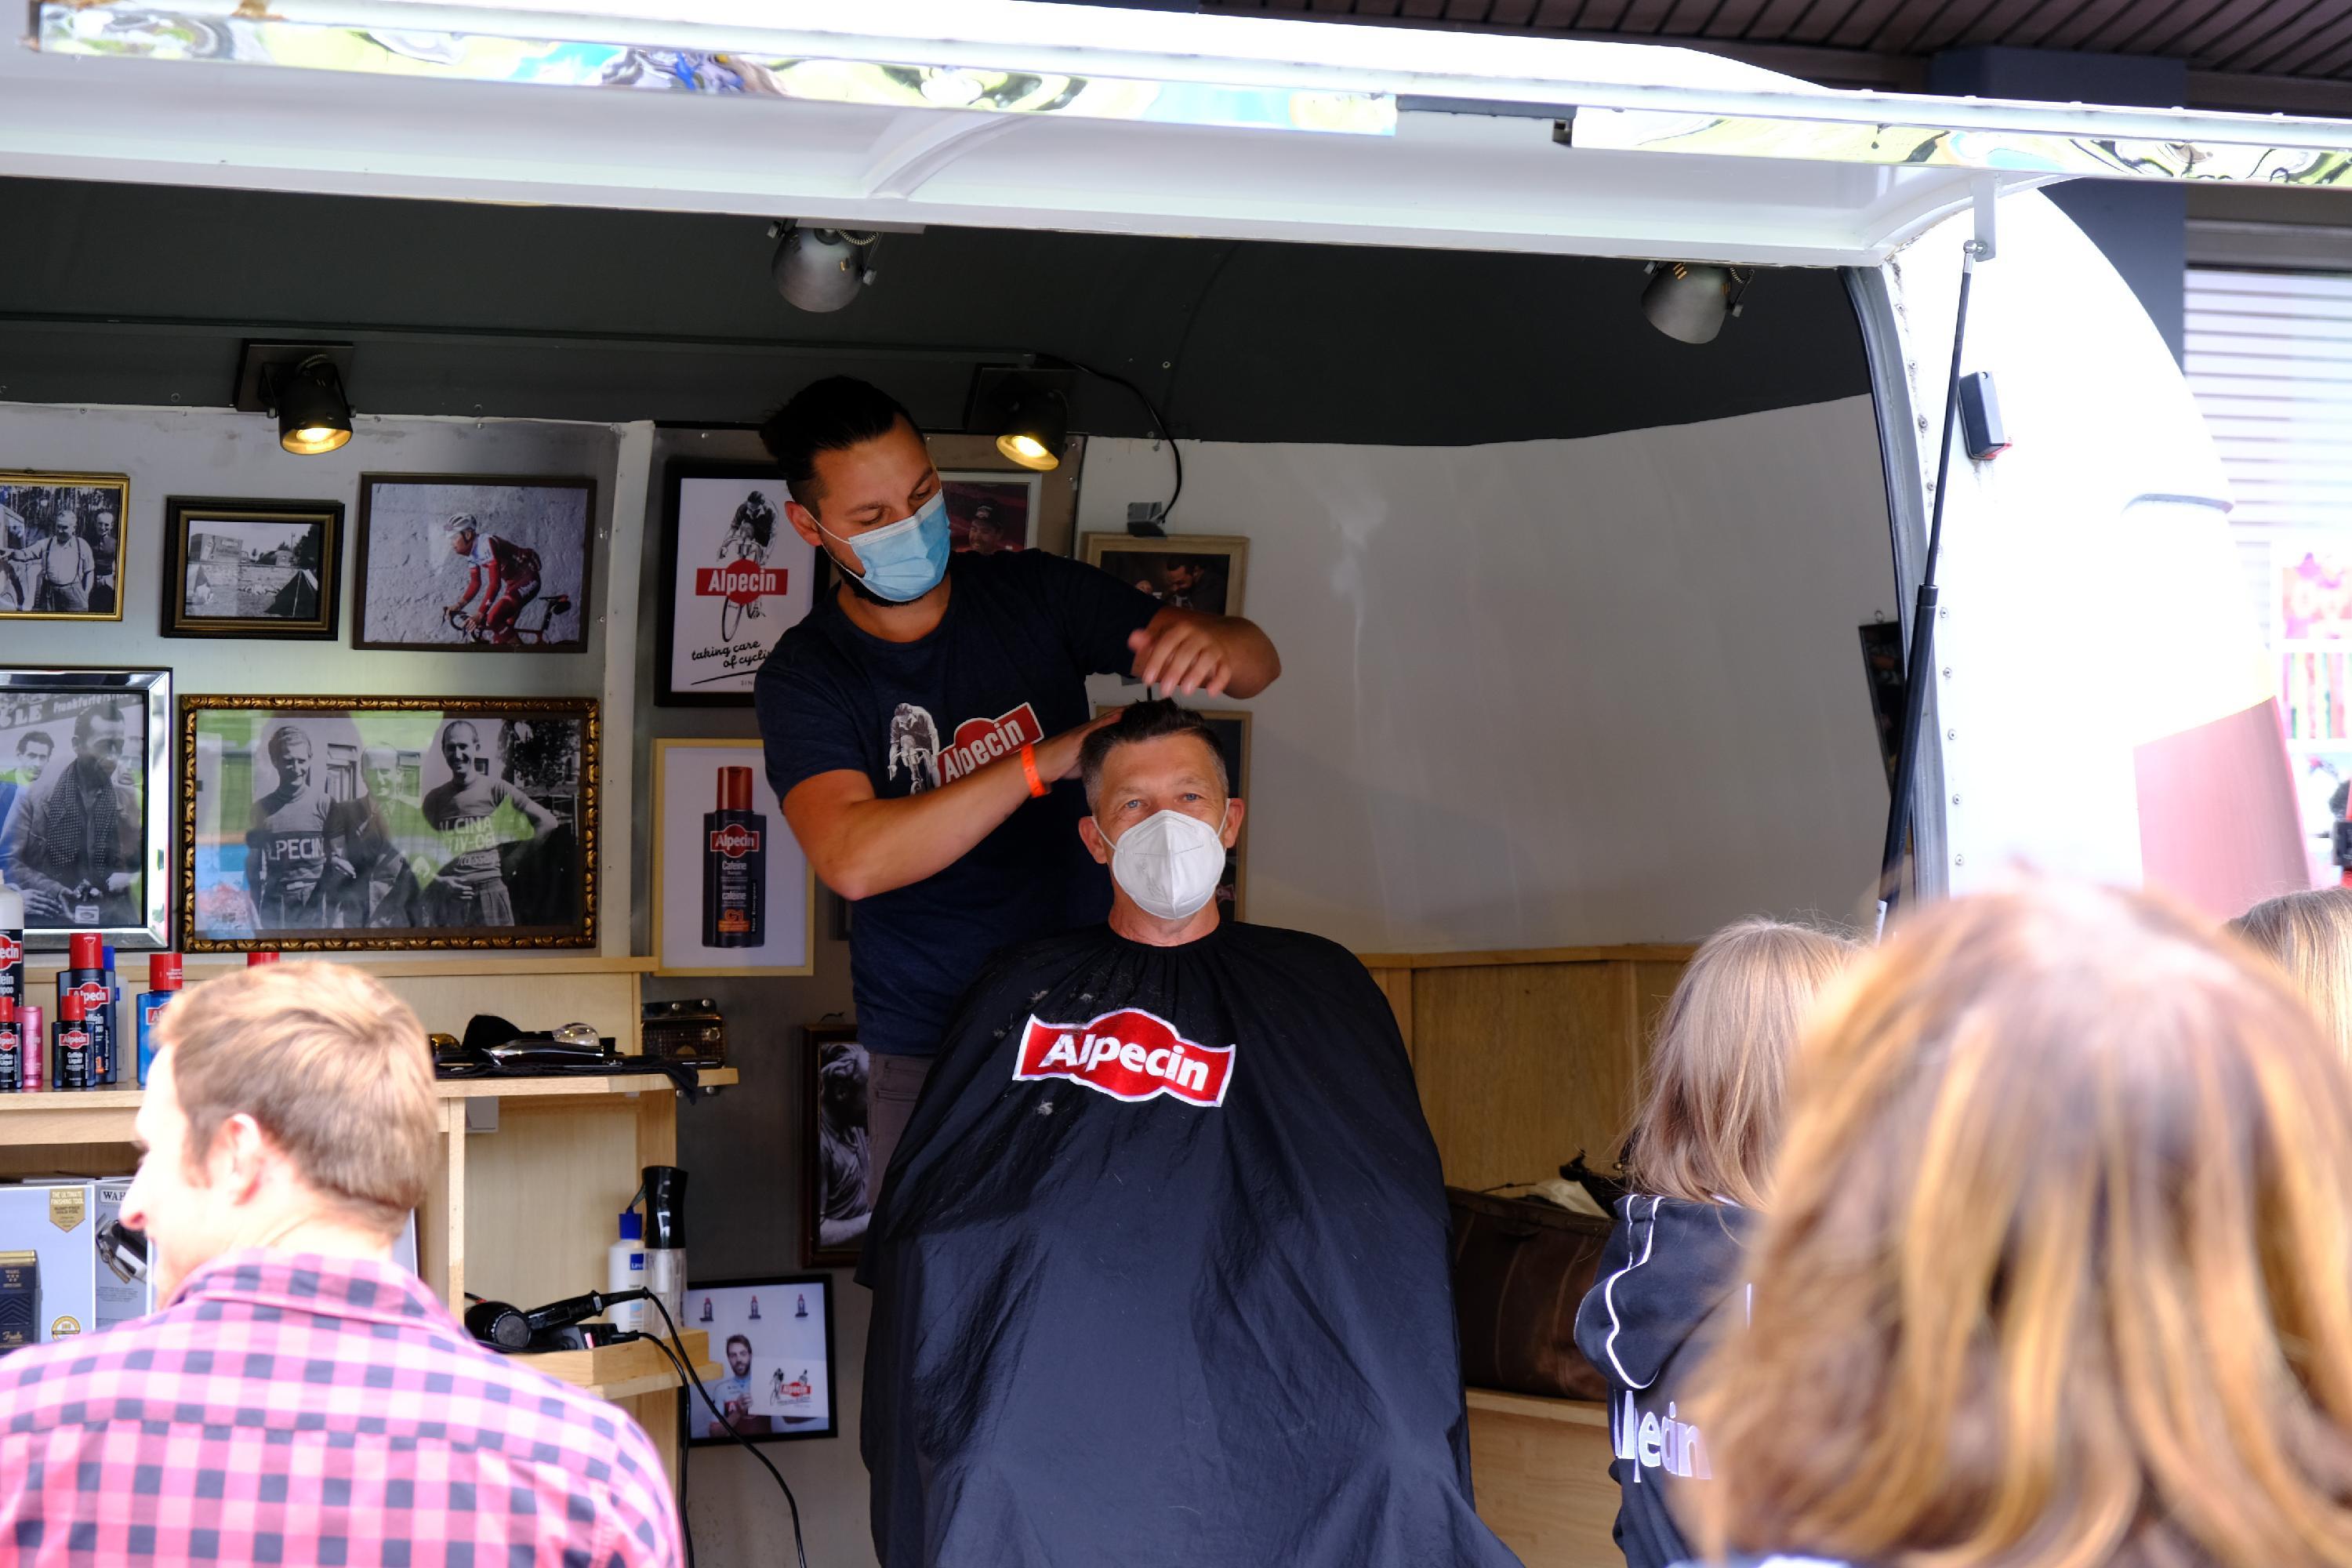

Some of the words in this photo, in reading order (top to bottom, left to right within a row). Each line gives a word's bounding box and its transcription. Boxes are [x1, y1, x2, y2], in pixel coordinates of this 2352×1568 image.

[708, 568, 776, 595] Alpecin
[691, 645, 731, 661] taking
[733, 640, 760, 652] care
[723, 655, 737, 669] of
[944, 719, 1025, 783] Alpecin
[266, 837, 325, 861] LPECIN
[715, 833, 754, 851] Alpecin
[0, 943, 19, 959] ecin
[63, 1036, 86, 1044] Alpecin
[1038, 1033, 1209, 1091] Alpecin
